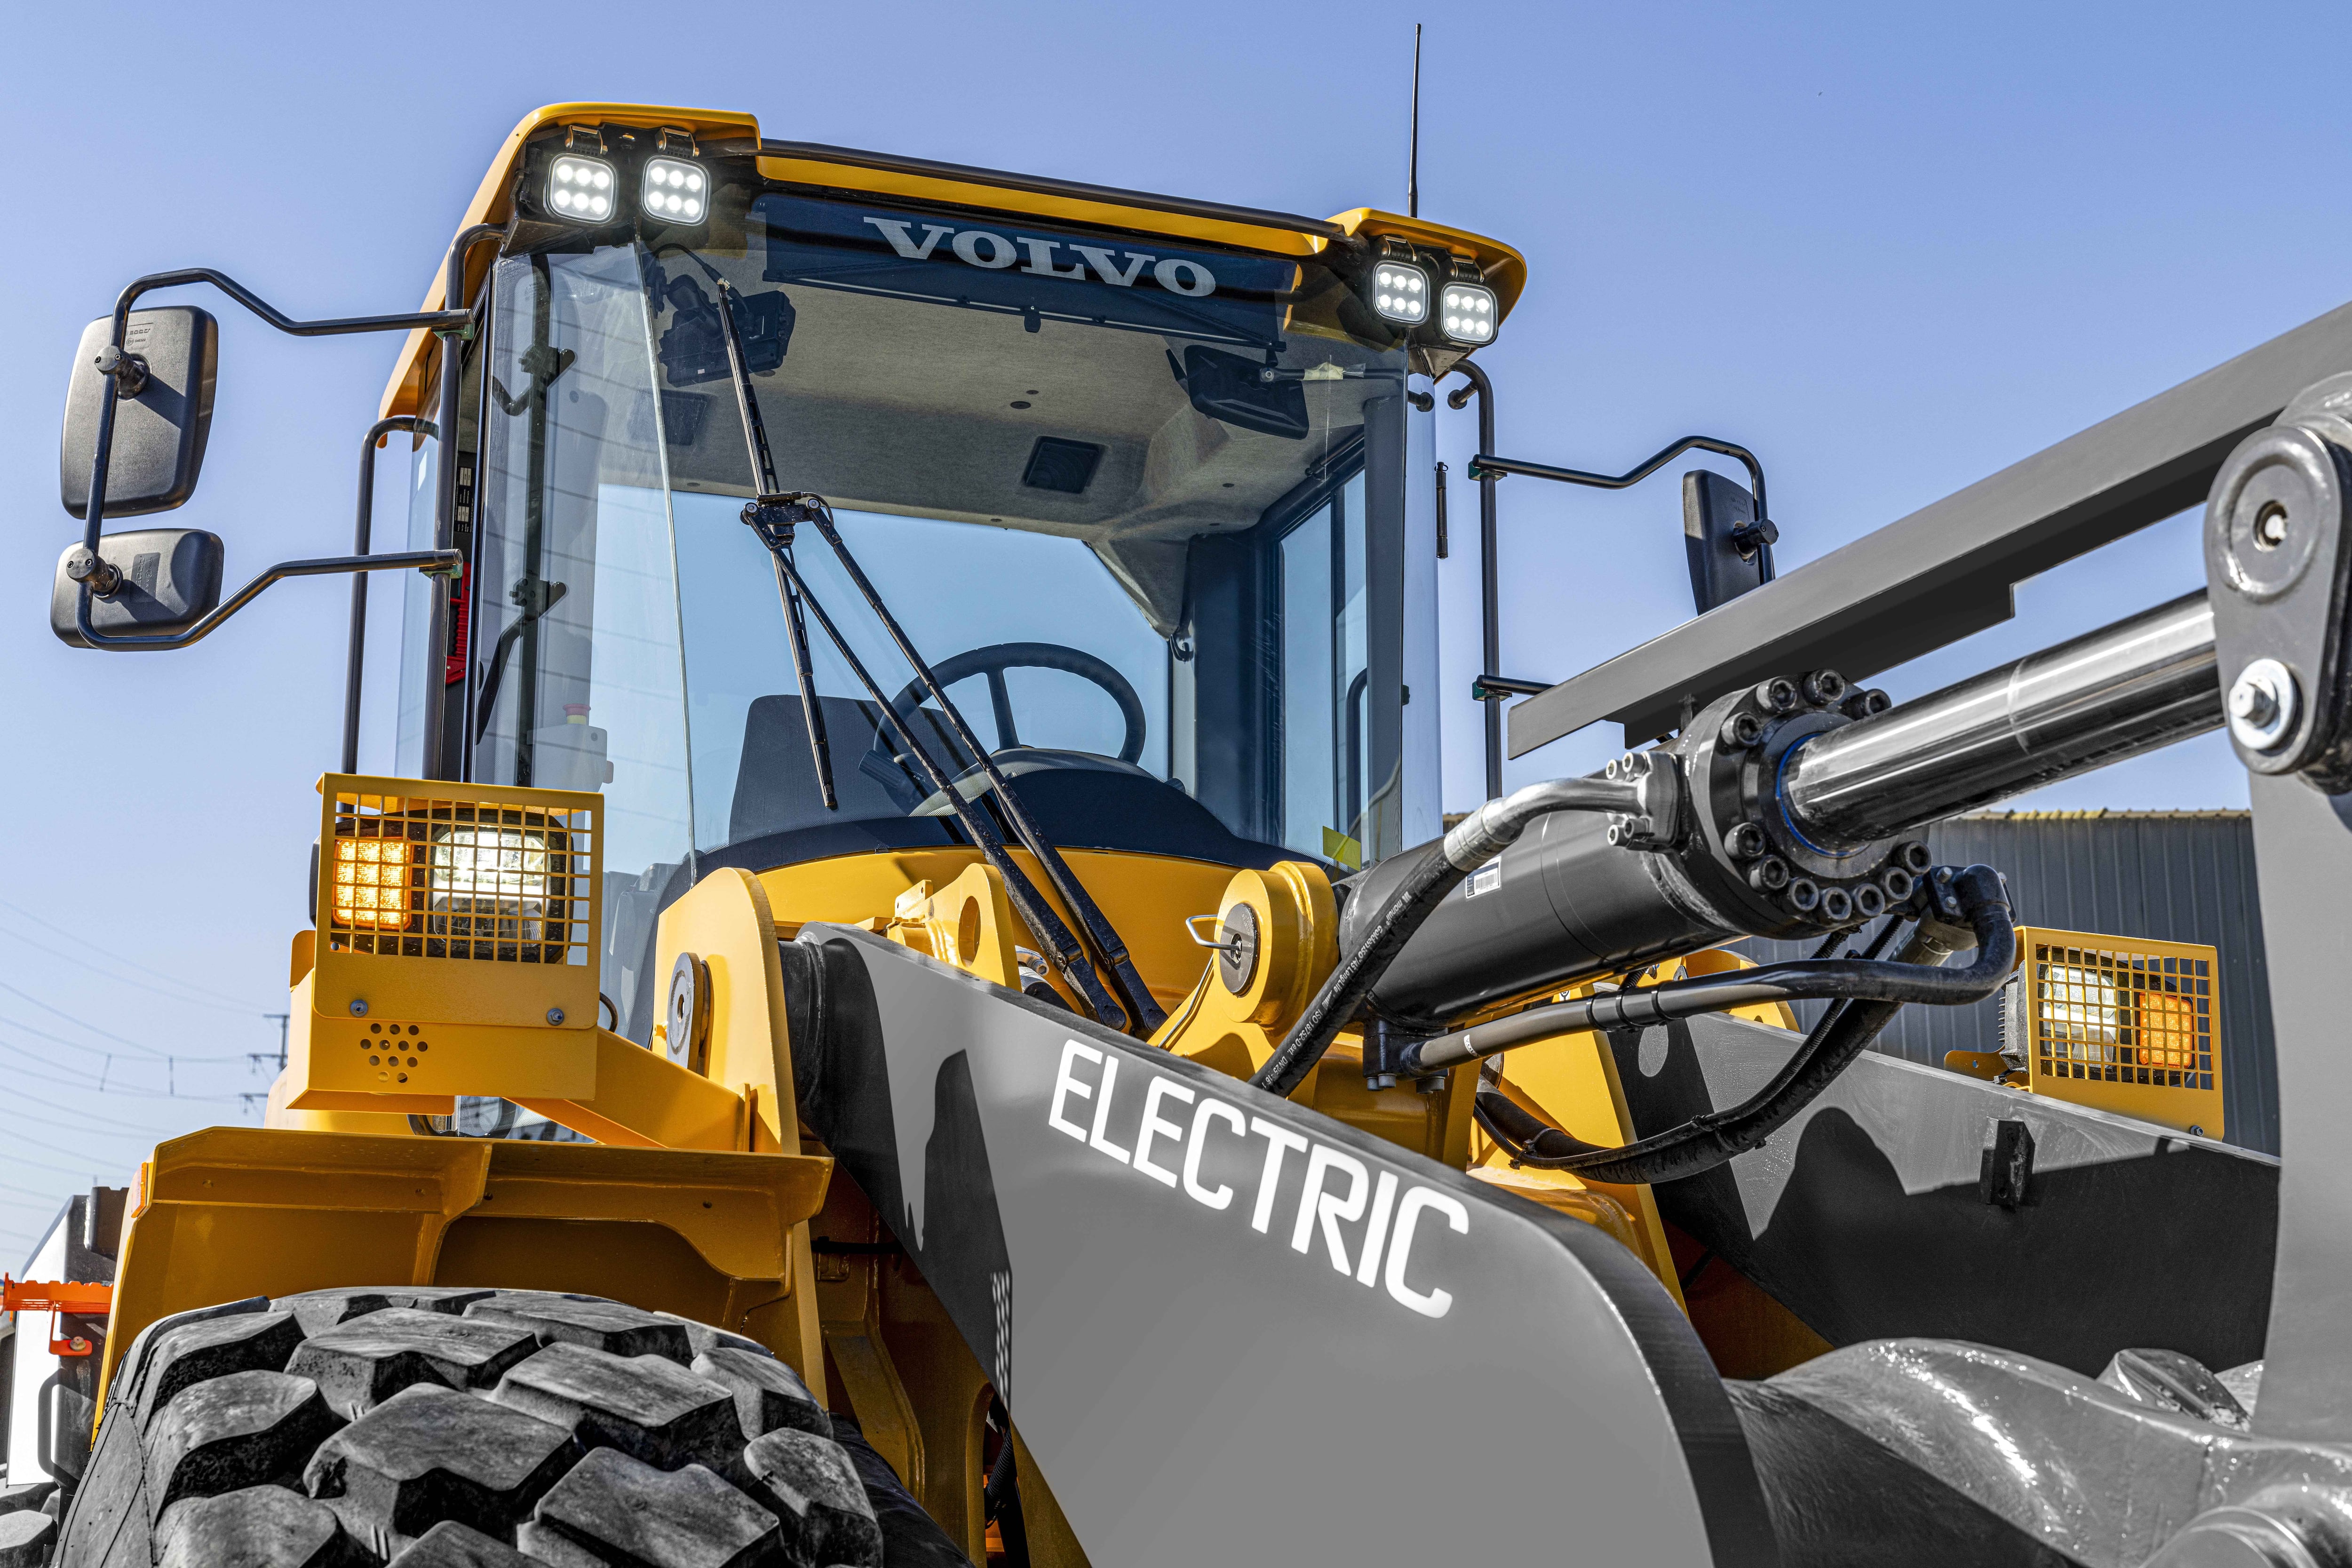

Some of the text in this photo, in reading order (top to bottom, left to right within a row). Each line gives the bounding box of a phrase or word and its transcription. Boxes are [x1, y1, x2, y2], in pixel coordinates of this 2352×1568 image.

[863, 216, 1216, 297] VOLVO
[1334, 967, 1355, 993] LongLife
[1312, 1009, 1323, 1024] ISO
[1295, 1021, 1314, 1046] 18752-D
[1287, 1041, 1297, 1056] ext.
[1049, 1039, 1469, 1318] ELECTRIC
